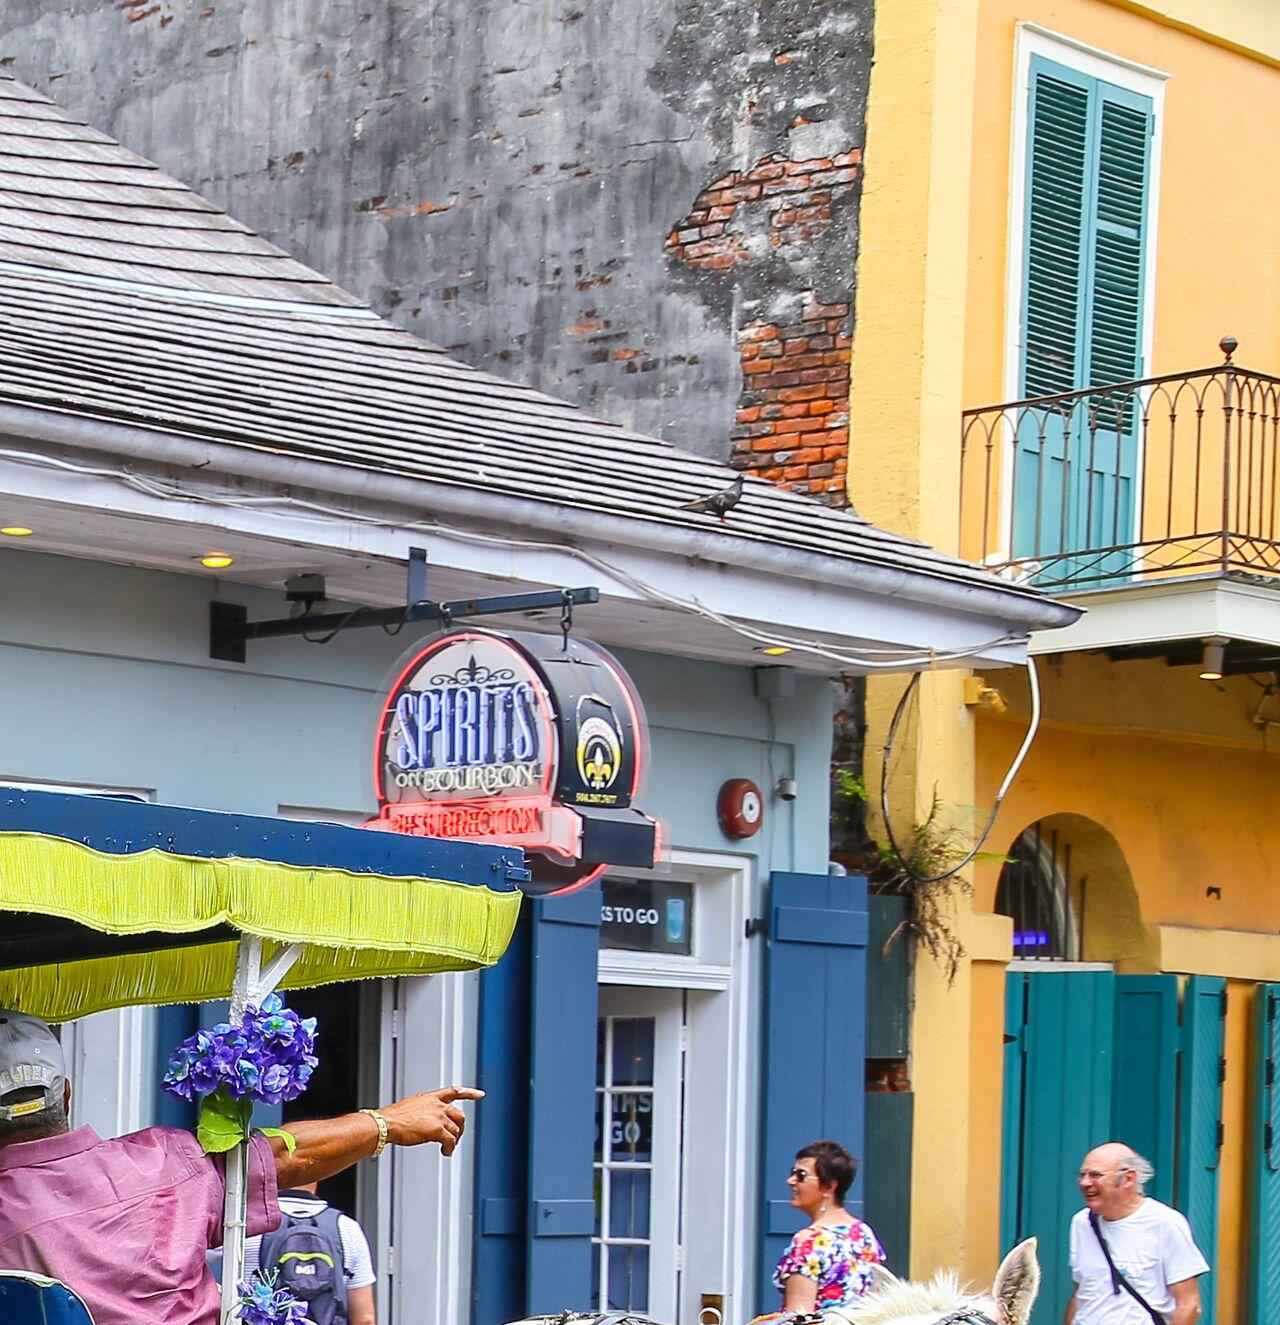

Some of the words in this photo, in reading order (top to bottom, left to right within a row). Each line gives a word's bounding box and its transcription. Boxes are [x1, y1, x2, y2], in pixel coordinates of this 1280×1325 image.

[396, 681, 538, 771] SPIRITS
[423, 764, 534, 796] BOURBON
[613, 906, 635, 924] TO
[635, 908, 659, 925] GO
